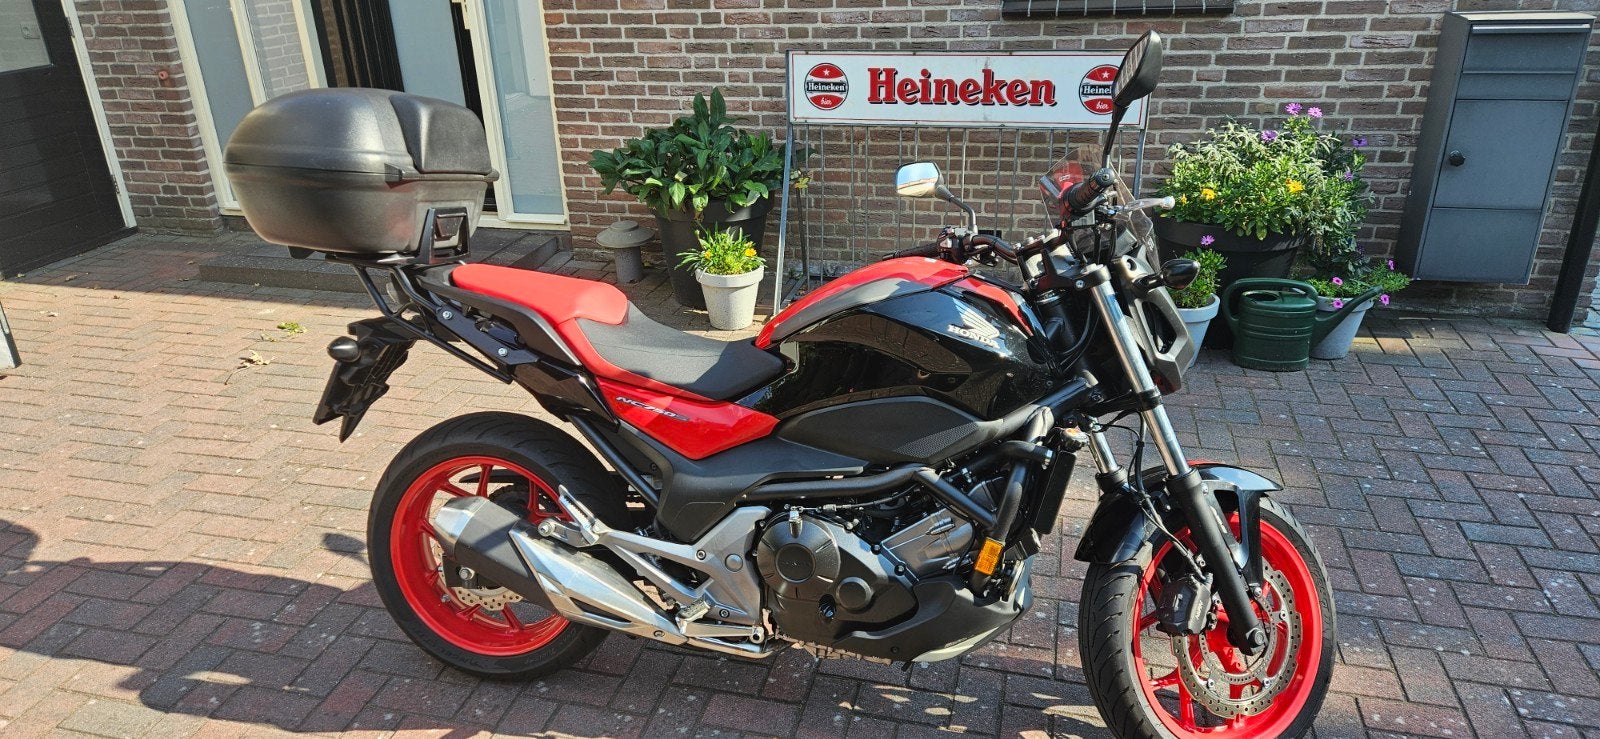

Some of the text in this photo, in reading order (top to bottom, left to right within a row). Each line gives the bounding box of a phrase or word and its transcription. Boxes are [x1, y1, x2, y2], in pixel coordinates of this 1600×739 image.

[808, 82, 845, 91] Heineken
[868, 68, 1057, 106] Heineken
[1083, 85, 1112, 95] Heine
[1096, 101, 1110, 110] bier
[948, 324, 1000, 349] HONDA
